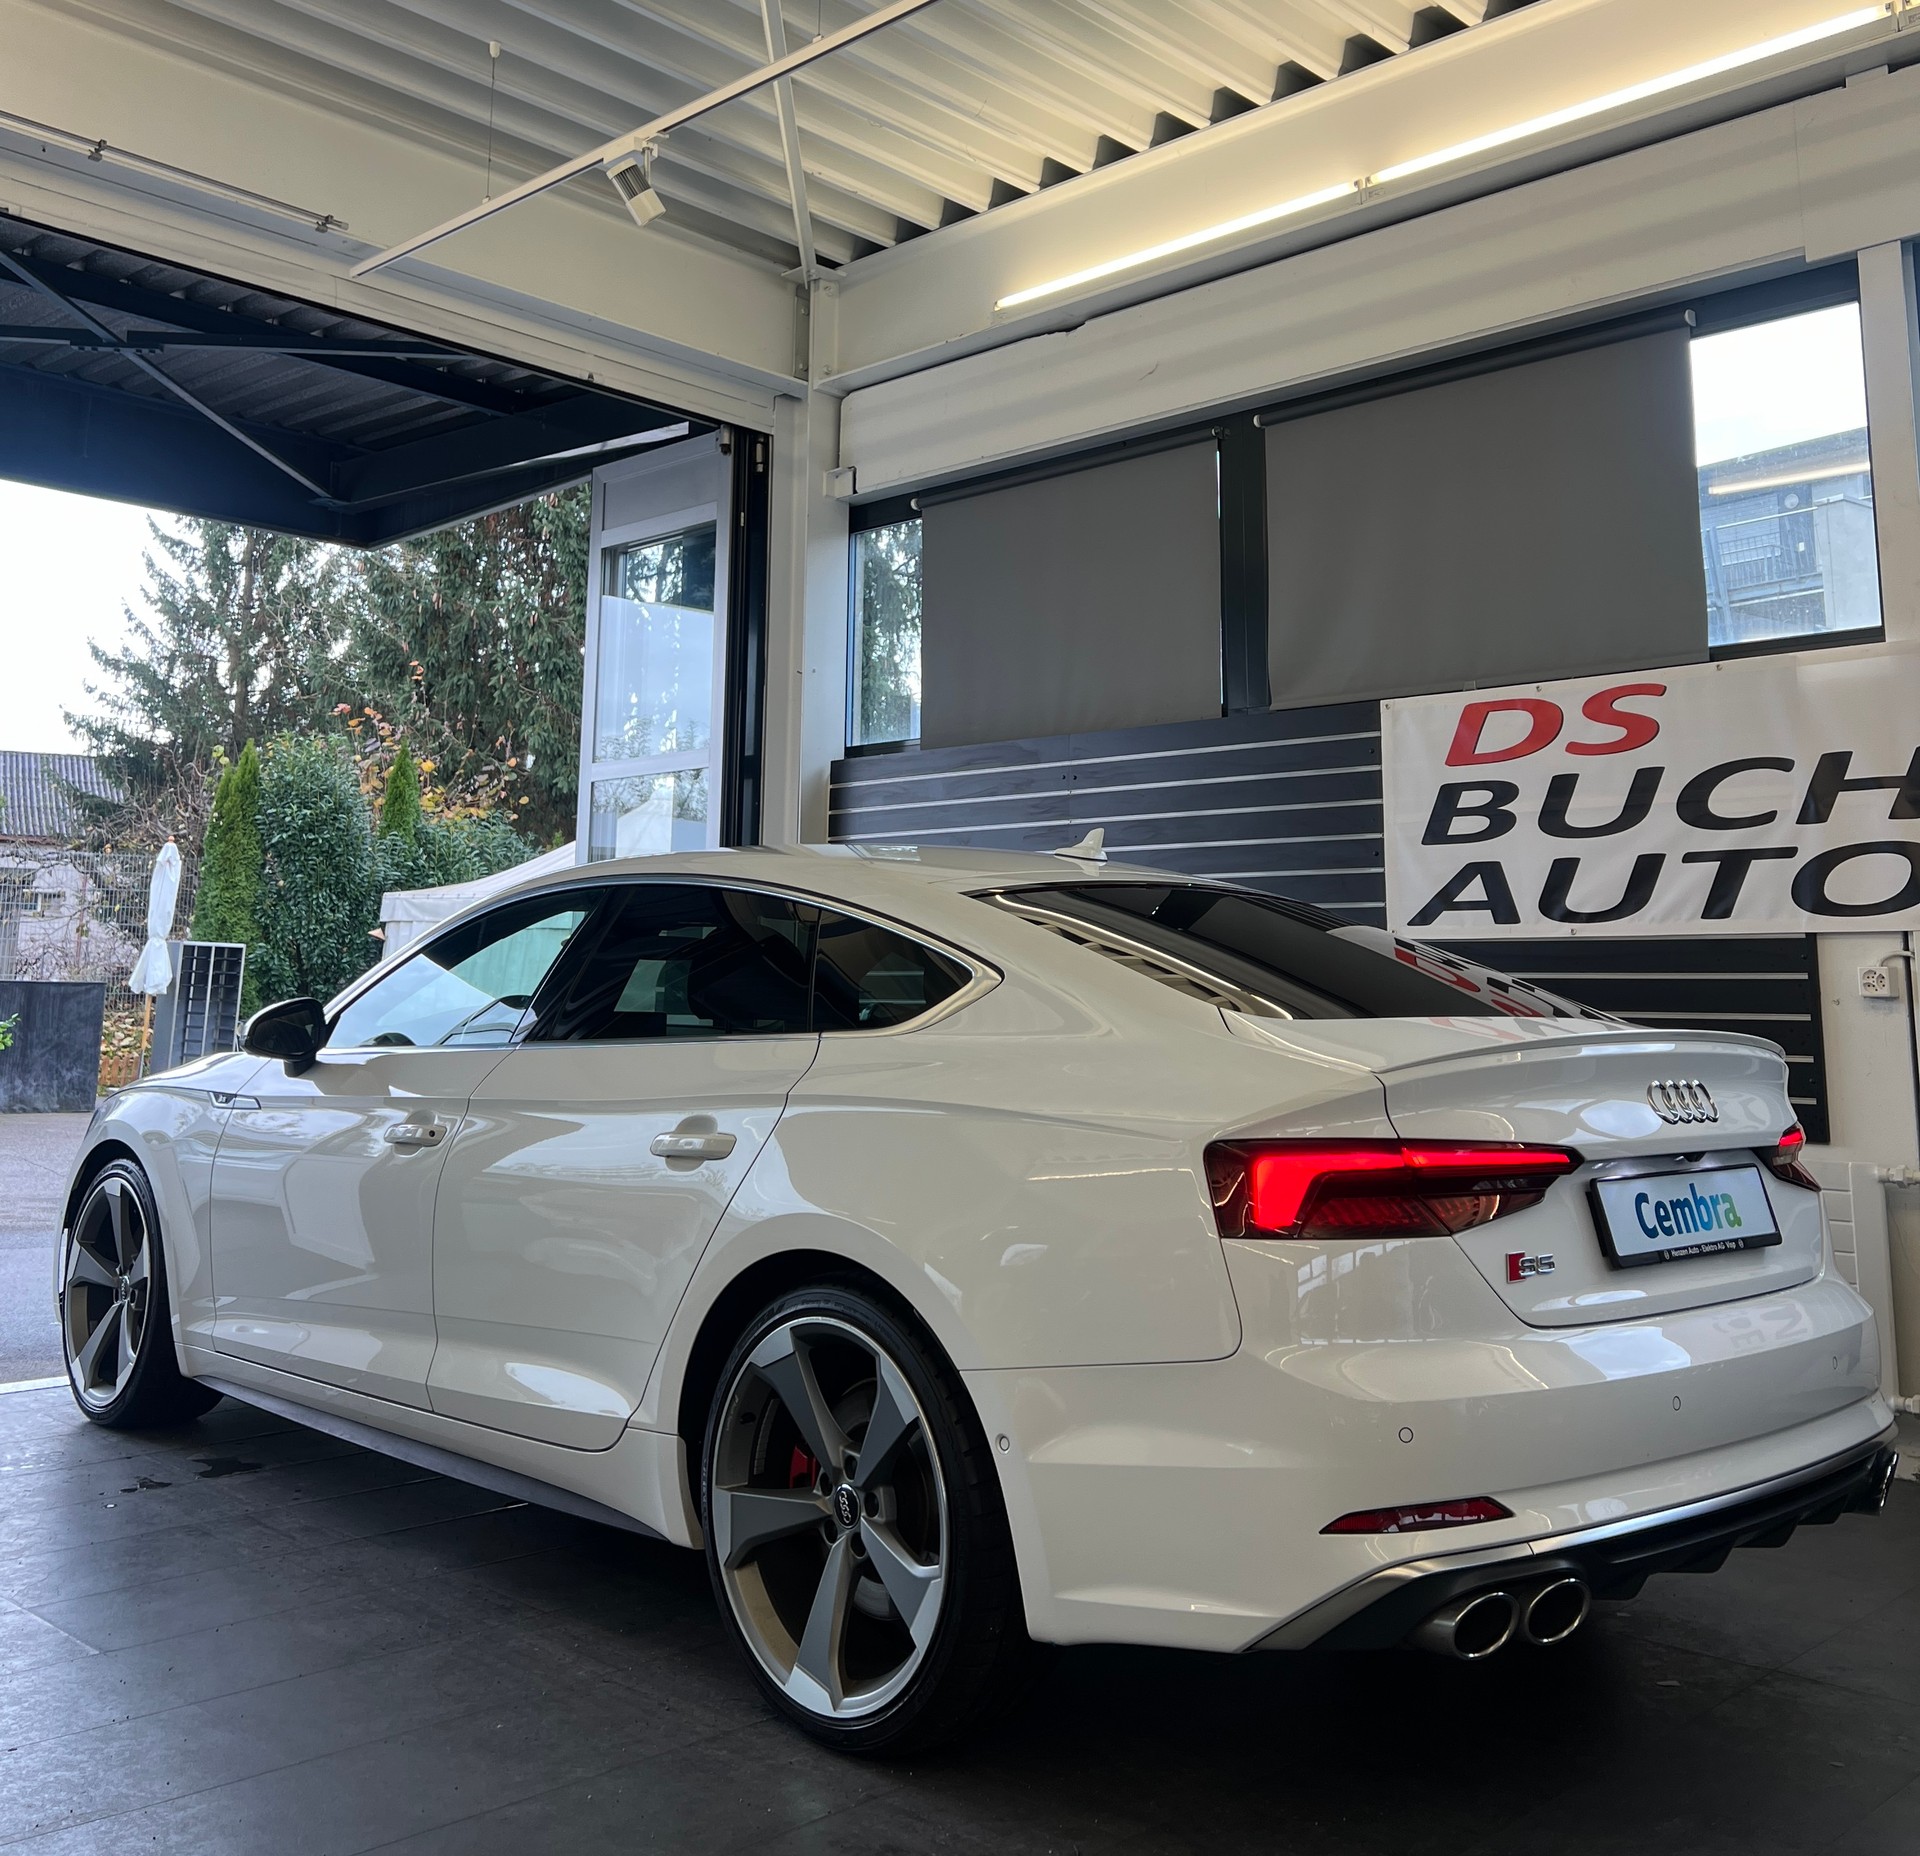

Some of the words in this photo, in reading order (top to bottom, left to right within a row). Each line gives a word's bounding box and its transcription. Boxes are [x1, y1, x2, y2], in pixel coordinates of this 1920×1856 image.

[1444, 682, 1668, 767] DS
[1421, 746, 1920, 845] BUCH
[1407, 840, 1920, 926] AUTO
[1634, 1182, 1742, 1239] Cembra
[1519, 1253, 1555, 1277] S5
